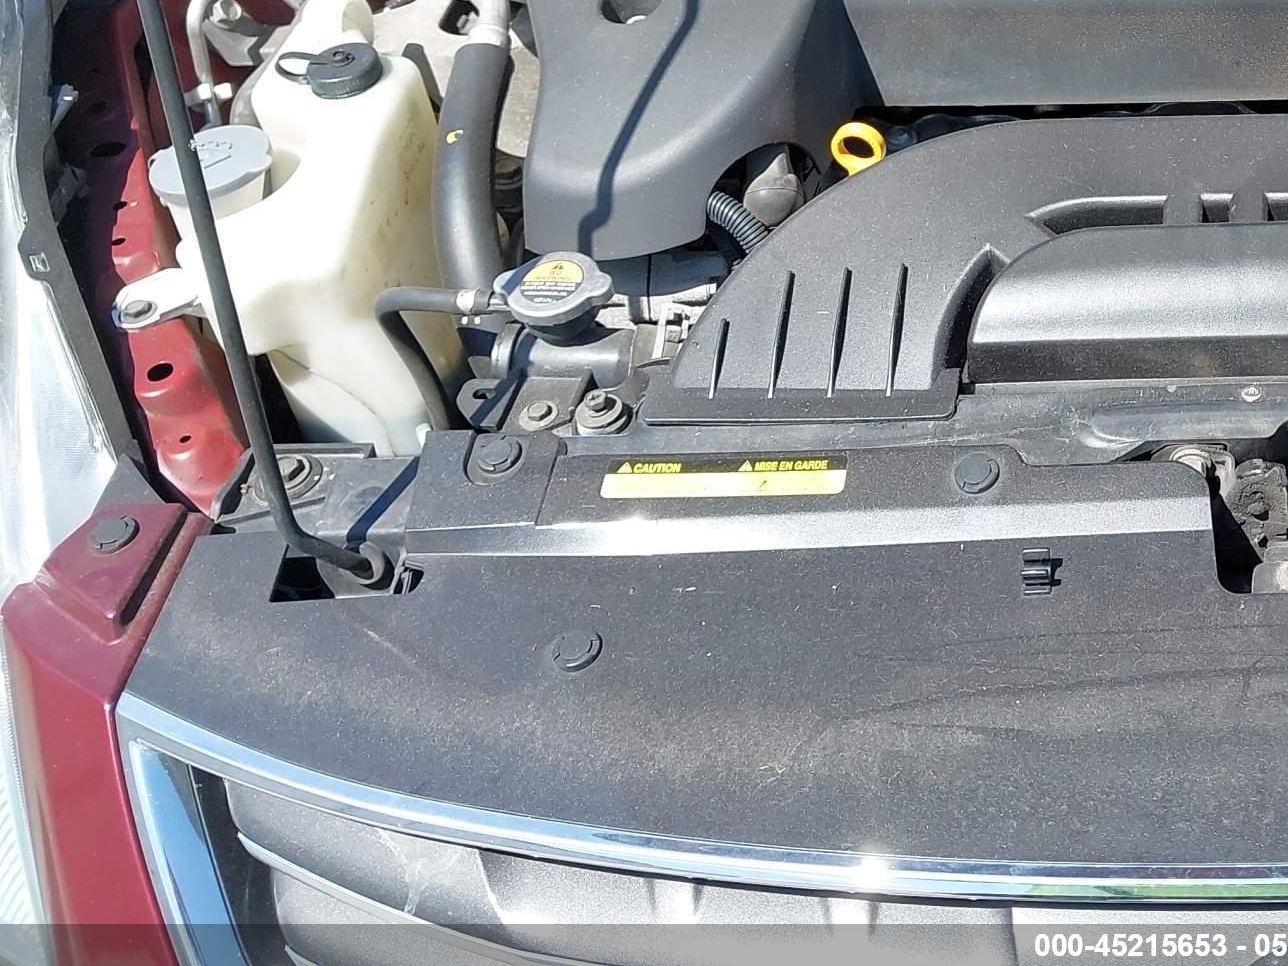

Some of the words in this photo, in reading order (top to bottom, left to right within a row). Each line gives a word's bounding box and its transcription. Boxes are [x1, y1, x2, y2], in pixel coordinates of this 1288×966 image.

[633, 462, 682, 474] CAUTION
[754, 461, 779, 471] MISE
[779, 461, 793, 471] EN
[794, 460, 828, 470] GARDE
